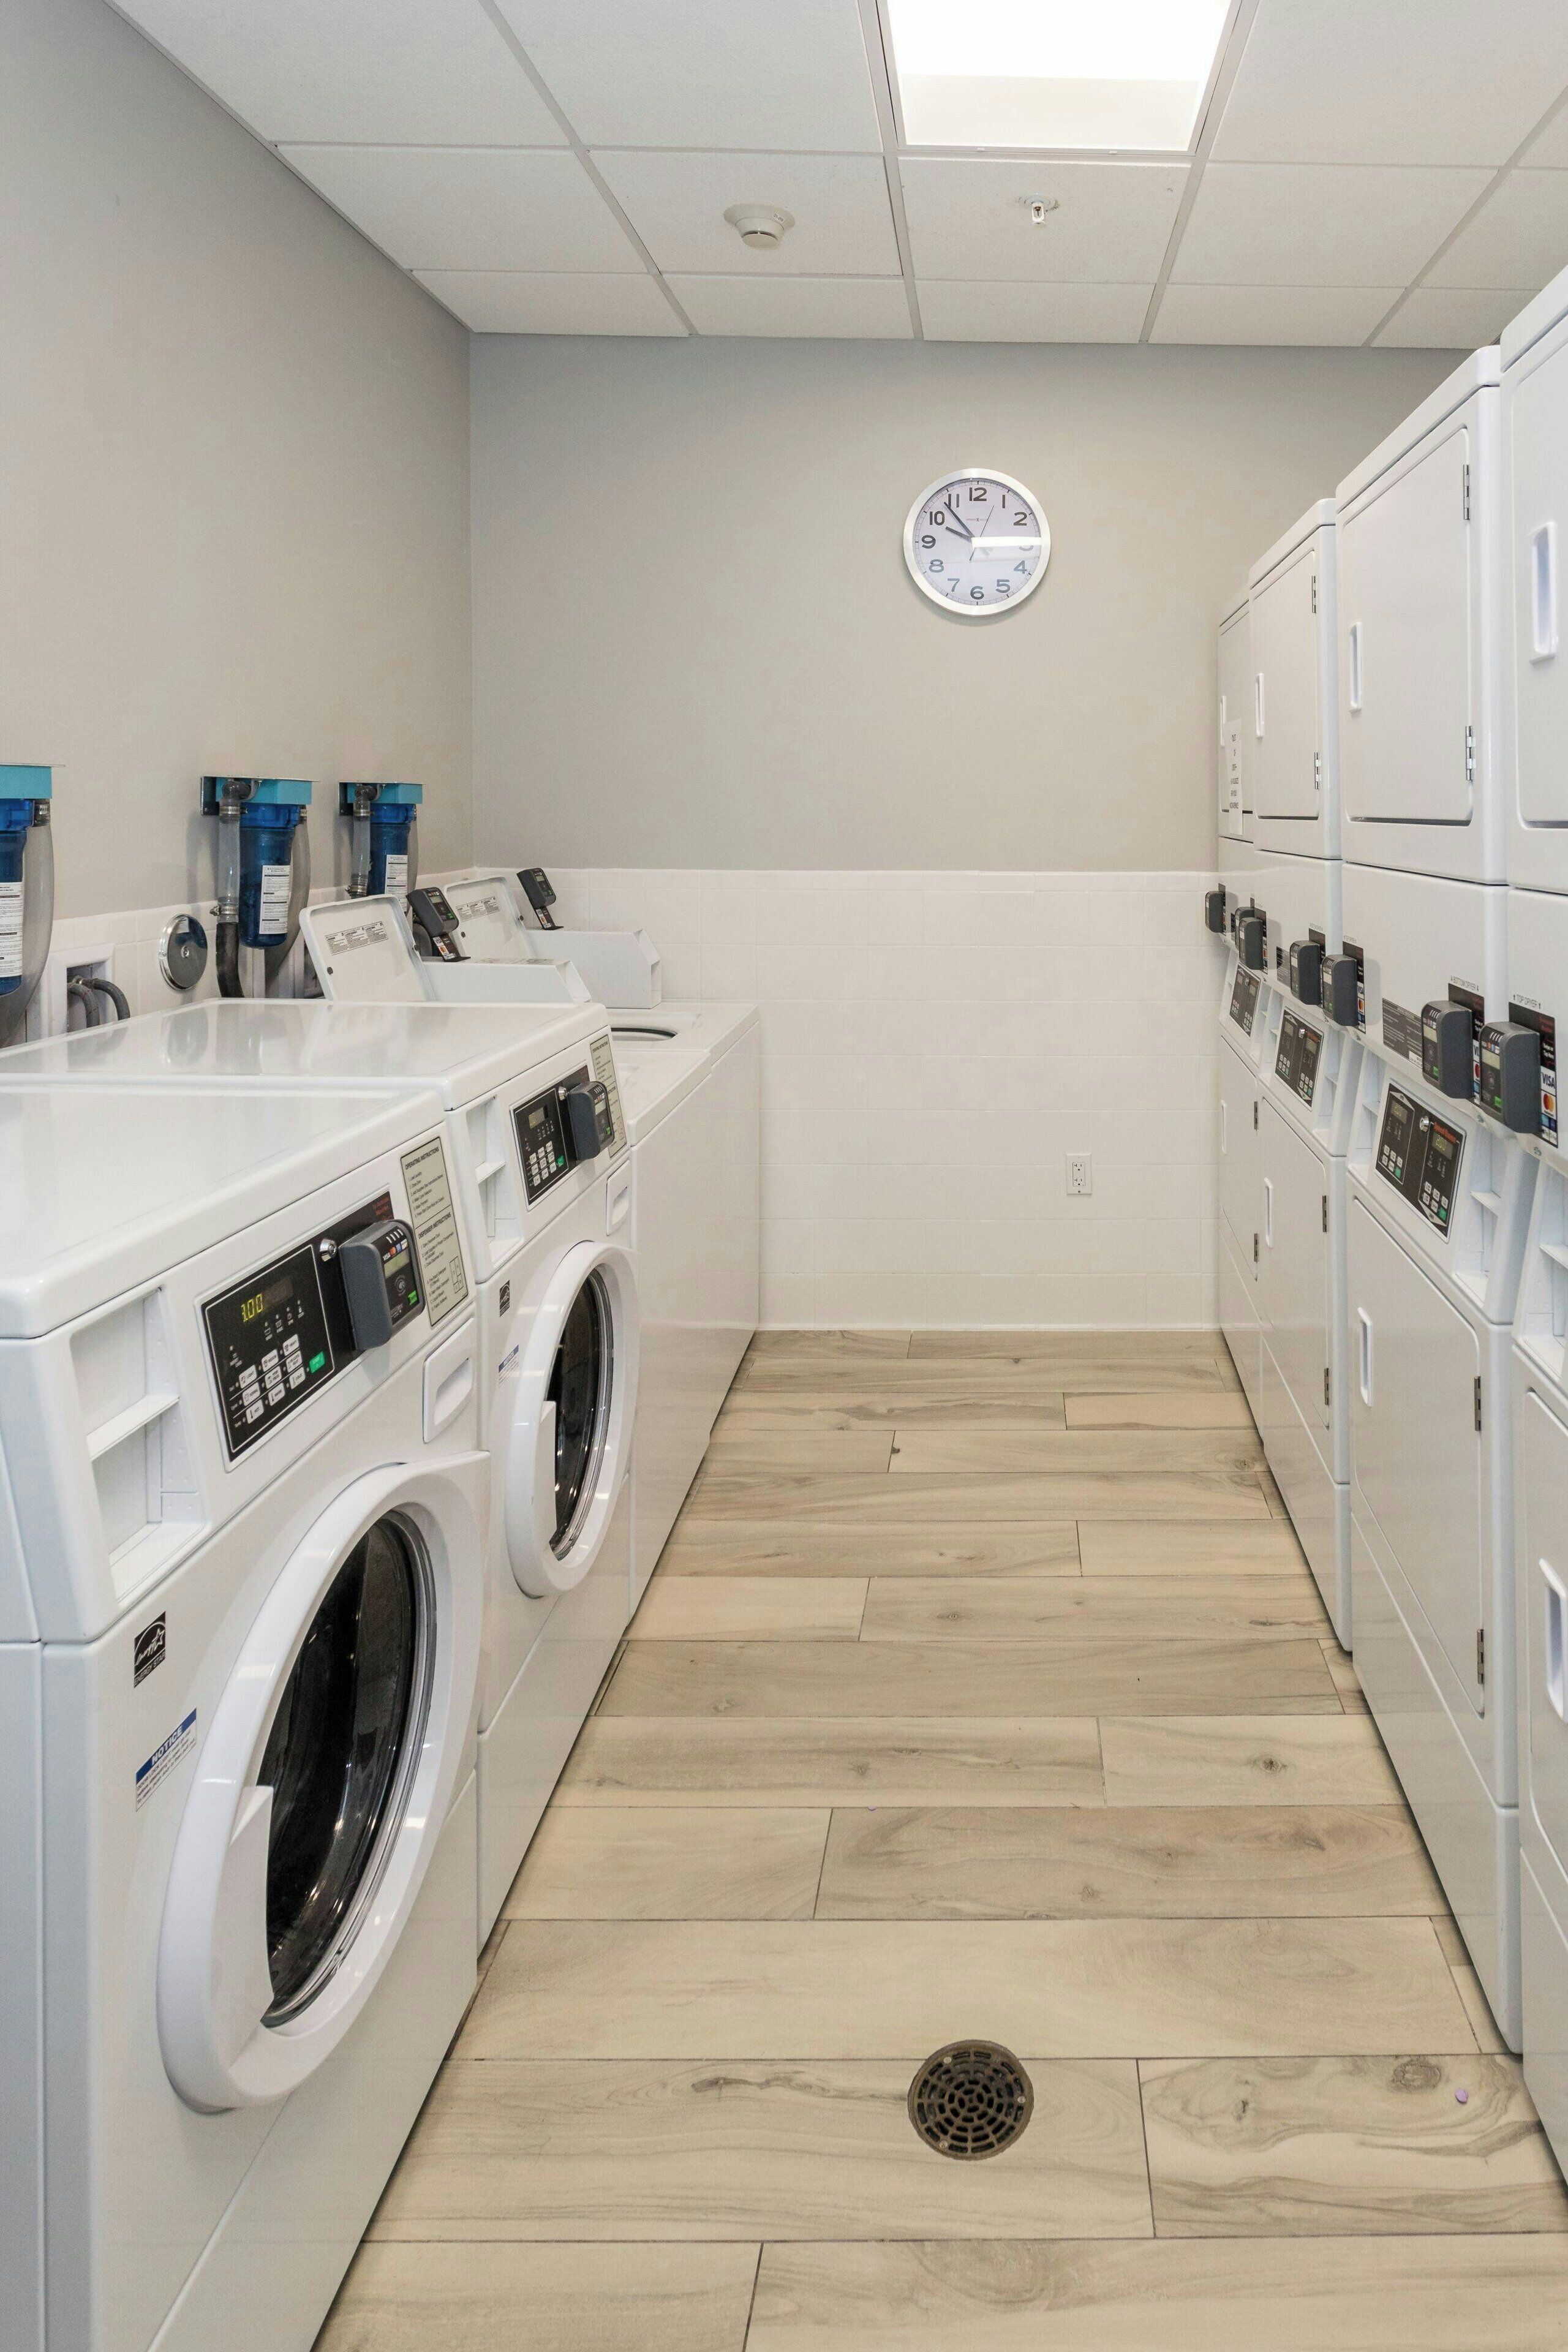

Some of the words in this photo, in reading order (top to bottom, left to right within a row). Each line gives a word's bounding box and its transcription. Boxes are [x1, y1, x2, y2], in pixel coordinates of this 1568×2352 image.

[948, 494, 959, 508] 11
[970, 487, 987, 501] 12
[1002, 495, 1005, 508] 1
[930, 511, 945, 526] 10
[1014, 512, 1027, 526] 2
[922, 535, 936, 549] 9
[929, 559, 944, 573] 8
[1014, 560, 1027, 574] 4
[948, 578, 960, 592] 7
[995, 579, 1010, 593] 5
[970, 586, 984, 600] 6
[1542, 1072, 1555, 1088] VISA
[152, 1725, 183, 1766] NOTICE
